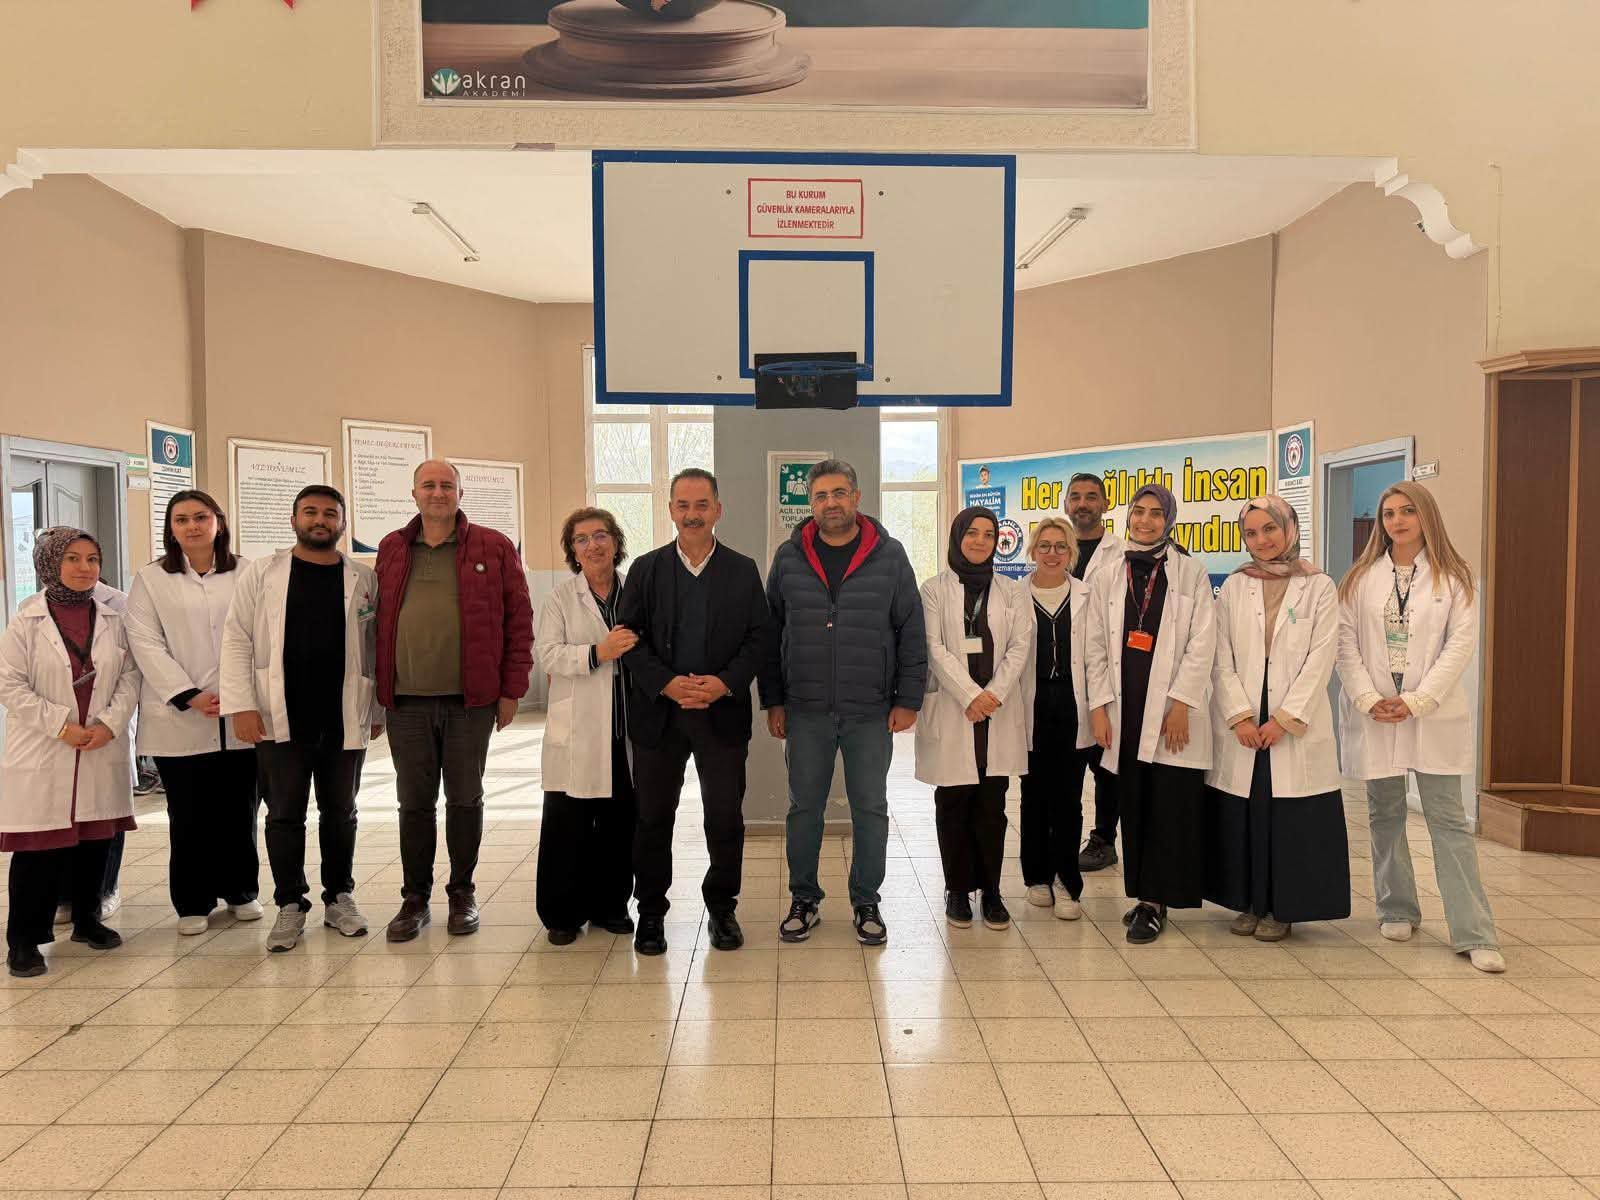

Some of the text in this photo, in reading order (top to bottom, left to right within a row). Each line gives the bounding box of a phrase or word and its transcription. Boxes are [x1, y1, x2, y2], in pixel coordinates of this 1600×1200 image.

[462, 70, 526, 89] akran
[786, 190, 826, 199] BU KURUM
[756, 203, 855, 215] GÜVENLİK KAMERALARIYLA
[777, 217, 835, 229] İZLENMEKTEDİR
[1021, 457, 1268, 511] Her ğlıı İnsan
[969, 496, 1001, 507] HAYALİM
[796, 507, 812, 515] DUR
[992, 564, 1038, 573] uzmanlar.com
